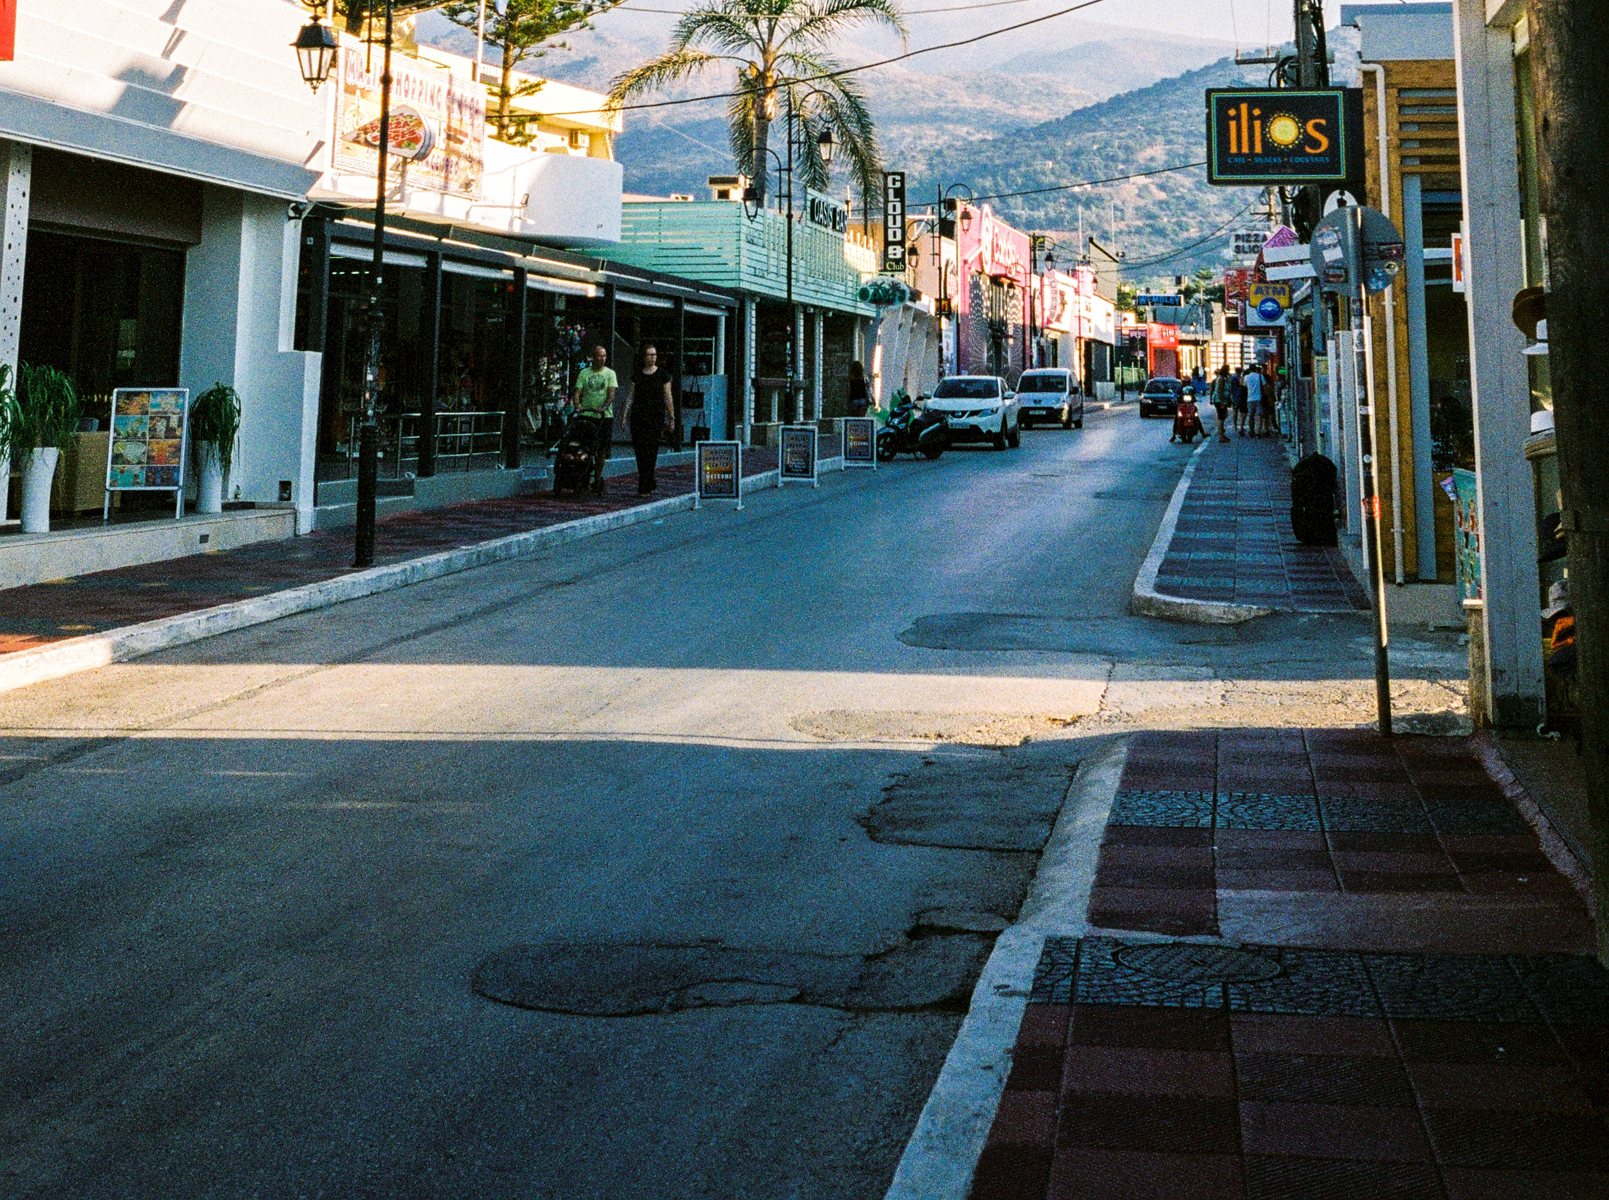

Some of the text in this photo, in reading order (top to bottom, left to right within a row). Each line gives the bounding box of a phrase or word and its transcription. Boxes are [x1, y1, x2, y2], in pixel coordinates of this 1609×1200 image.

[389, 68, 442, 110] HOPPING
[370, 119, 411, 133] PZZA
[1228, 102, 1329, 154] ilios
[371, 129, 418, 144] SICES
[887, 175, 902, 241] CLOUD
[1234, 233, 1269, 243] PIZZA
[1234, 244, 1262, 254] SLIC
[886, 261, 905, 271] Club
[1254, 285, 1287, 297] ATM
